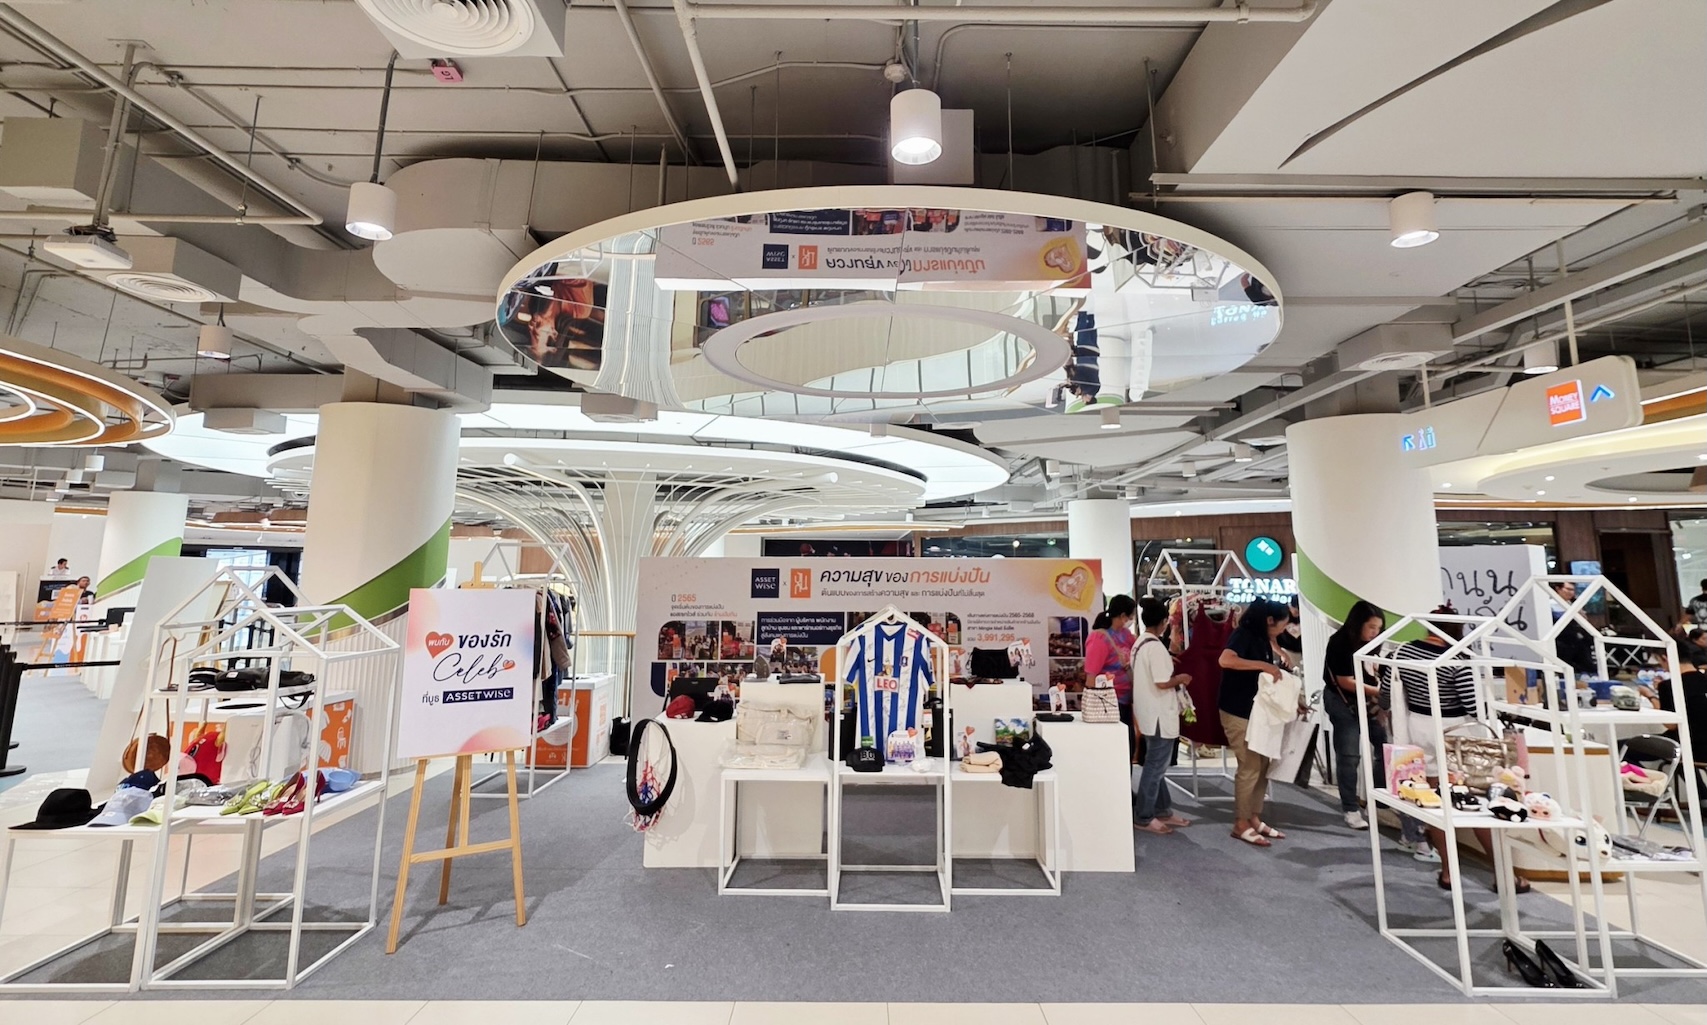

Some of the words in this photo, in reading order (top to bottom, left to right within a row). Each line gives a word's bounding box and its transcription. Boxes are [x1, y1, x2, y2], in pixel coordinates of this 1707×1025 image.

[677, 593, 697, 602] 2565
[428, 637, 451, 647] พบกับ
[458, 629, 512, 649] ของรัก
[977, 633, 1015, 643] 3,991,295
[433, 652, 503, 684] Celeb
[876, 677, 898, 690] LEO
